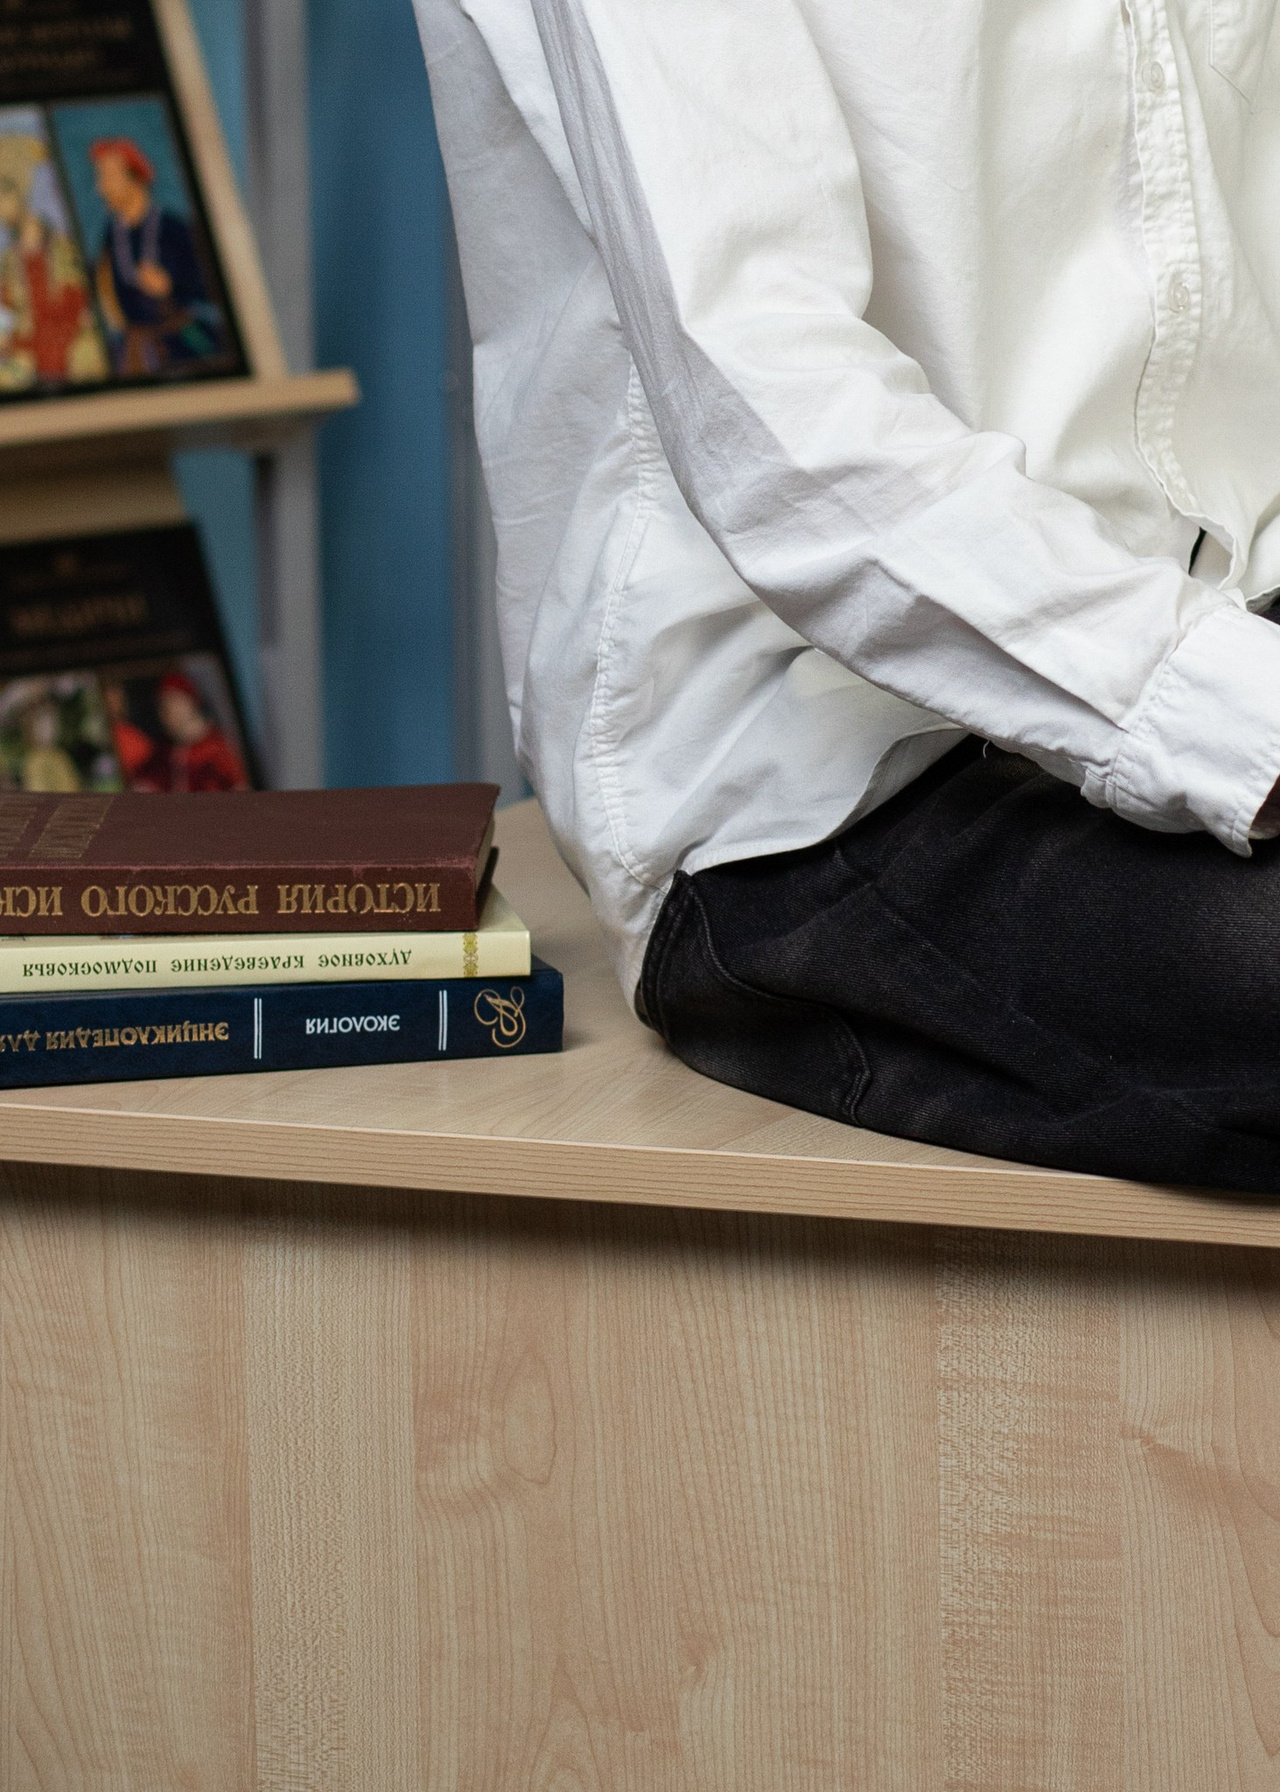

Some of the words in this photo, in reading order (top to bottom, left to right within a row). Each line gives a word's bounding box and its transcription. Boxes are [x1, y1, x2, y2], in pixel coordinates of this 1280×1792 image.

[80, 884, 260, 918] РУССКОГО
[277, 882, 442, 914] ИСТОРИЯ
[22, 957, 158, 977] ПОДМОСКОВЬЯ
[170, 954, 304, 974] КРАЕВЕДЕНИЕ
[318, 948, 412, 968] ДУХОВНОЕ
[45, 1020, 230, 1051] ЭНЦИКЛОПЕДИЯ
[305, 1014, 401, 1036] ЭКОЛОГИЯ
